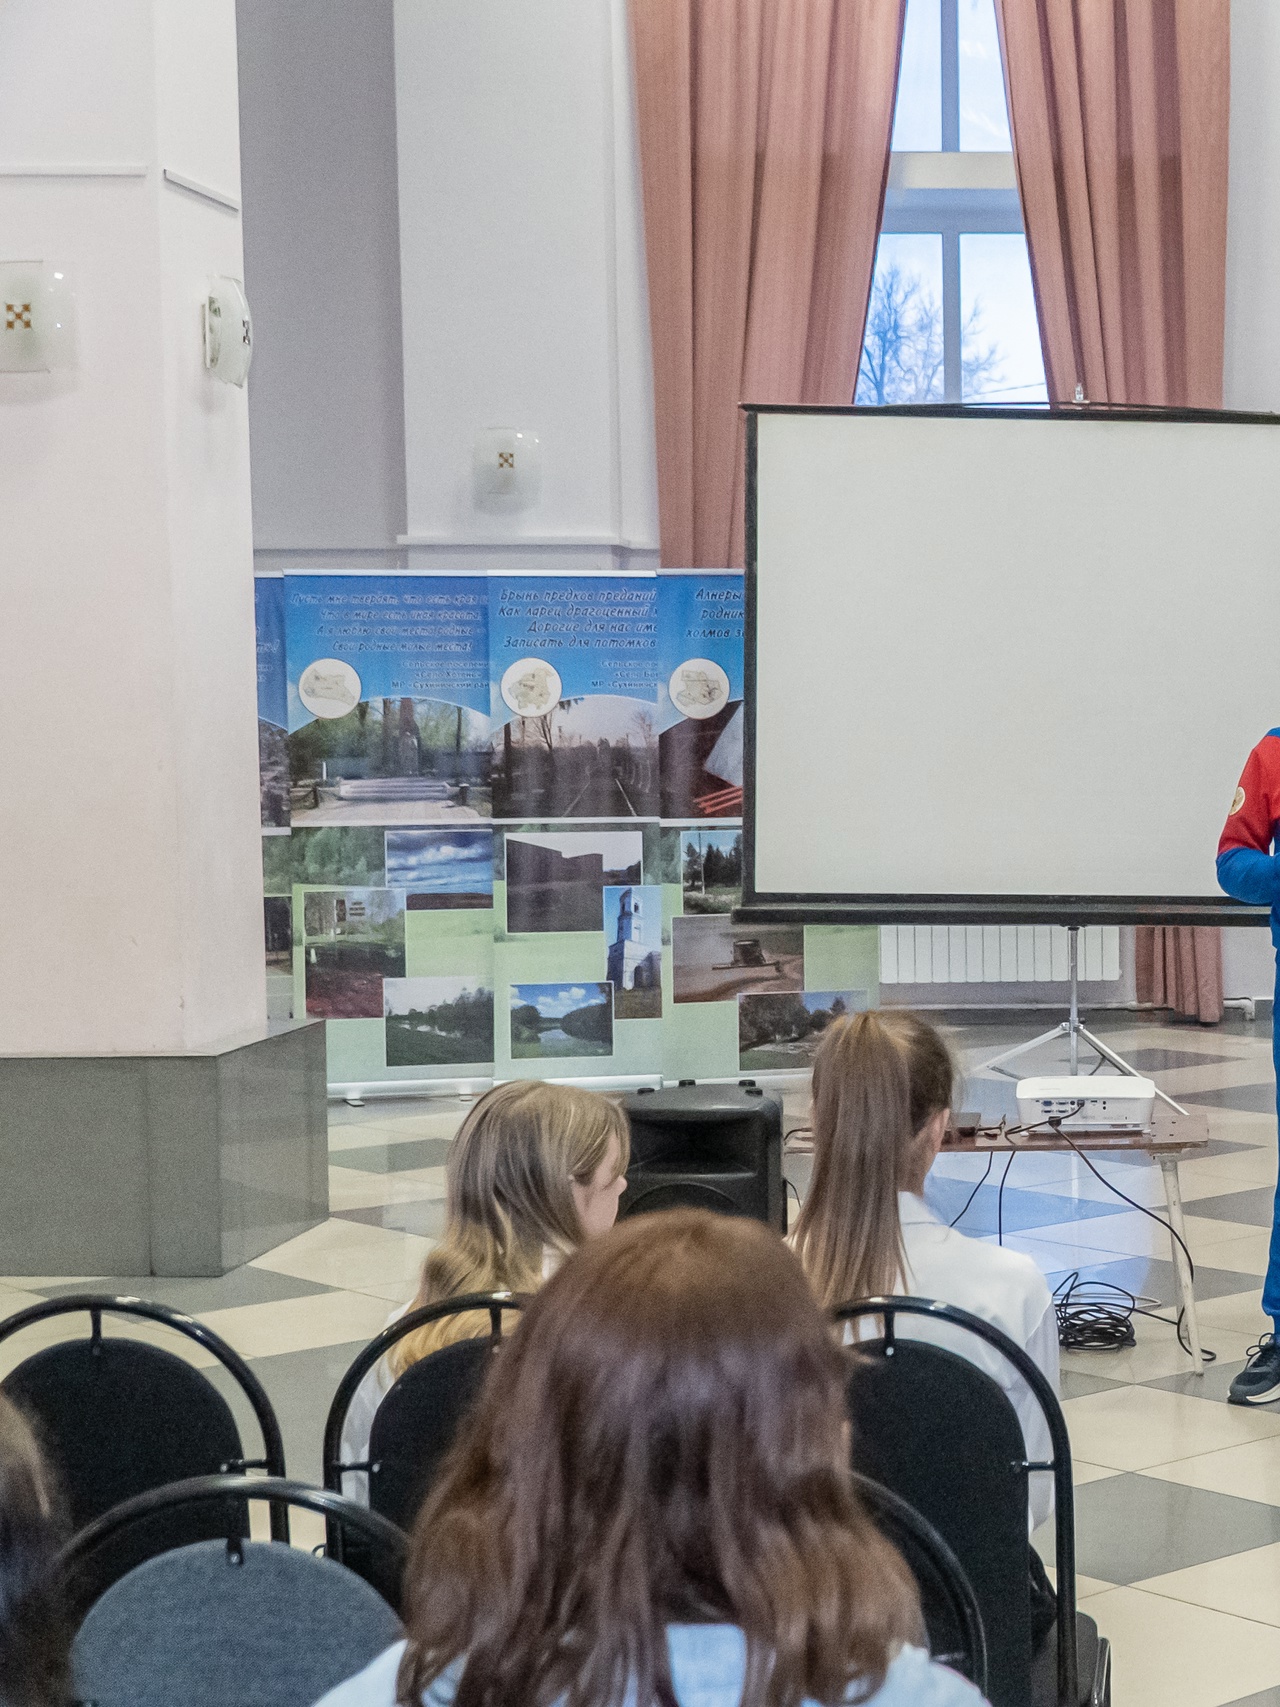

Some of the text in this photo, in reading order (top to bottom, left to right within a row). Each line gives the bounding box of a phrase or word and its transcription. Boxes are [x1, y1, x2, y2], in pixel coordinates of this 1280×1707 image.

[326, 595, 347, 604] мне
[501, 588, 539, 601] Брынь
[543, 588, 593, 603] предков
[598, 588, 657, 602] преданий
[498, 606, 521, 616] Как
[526, 606, 562, 618] ларец
[566, 605, 649, 618] драгоценный
[336, 623, 370, 635] люблю
[527, 621, 580, 634] Дорогие
[584, 621, 605, 633] для
[609, 624, 631, 632] нас
[686, 629, 730, 638] холмов
[504, 636, 656, 648] Записать для потомков
